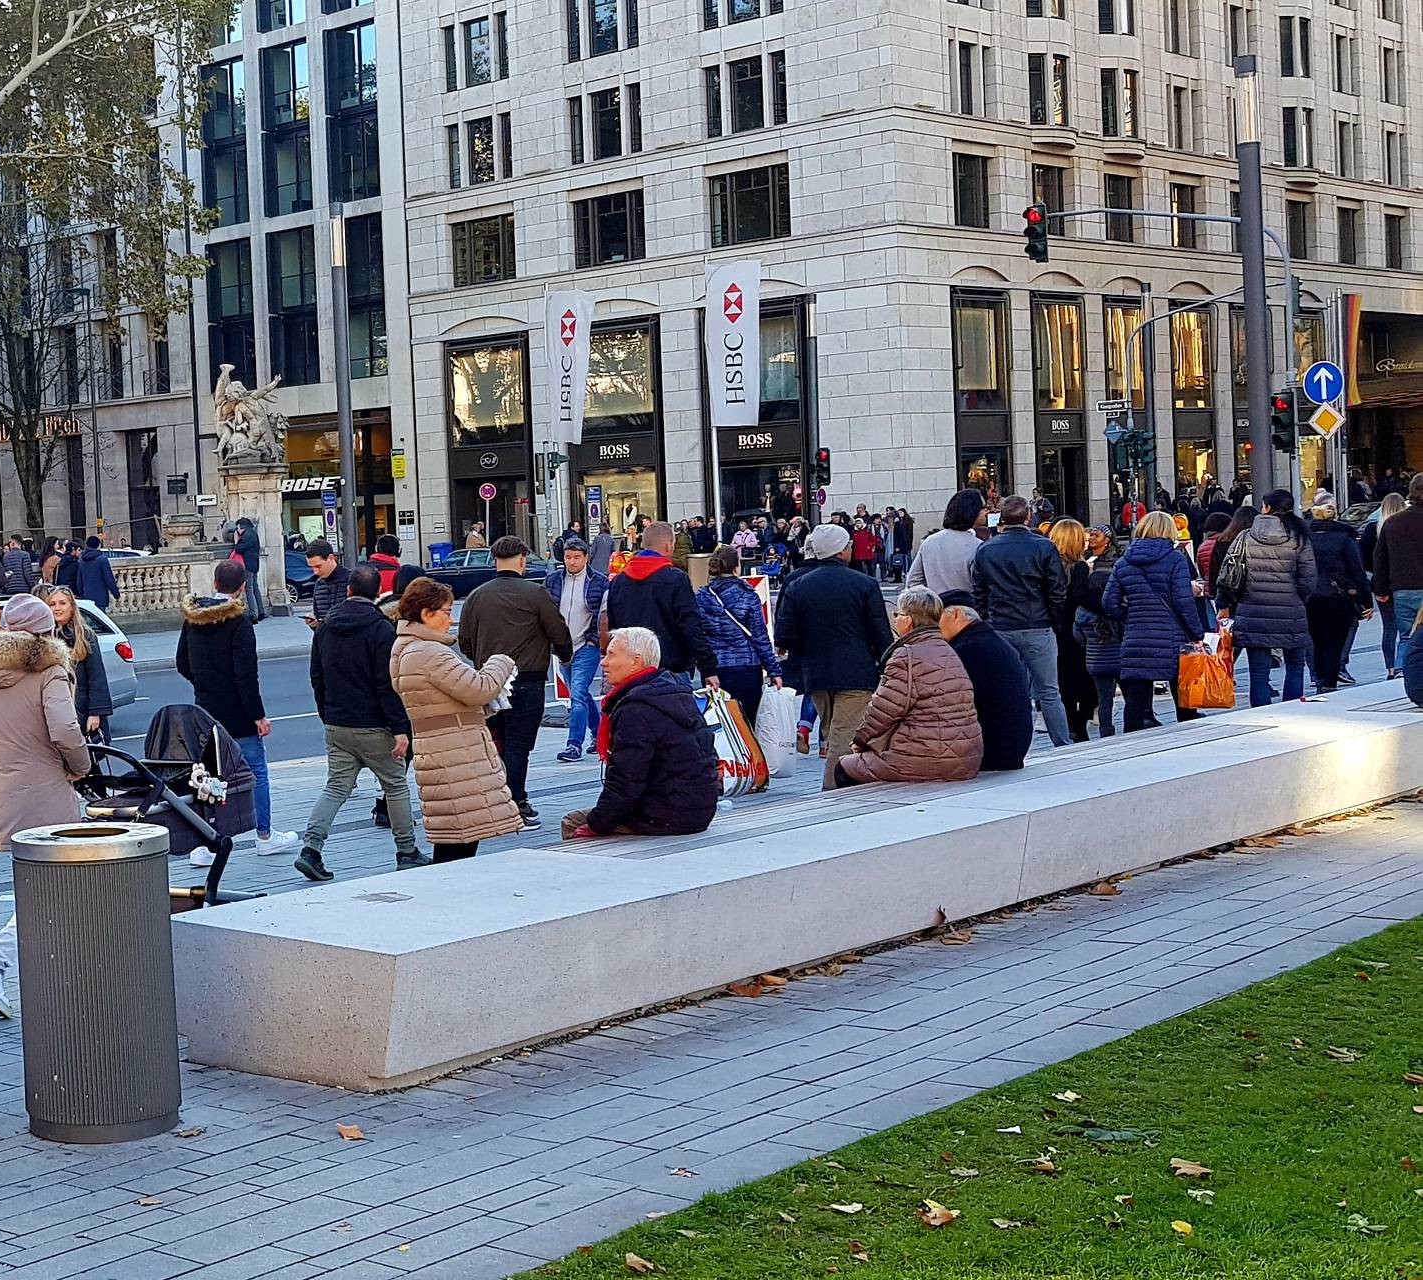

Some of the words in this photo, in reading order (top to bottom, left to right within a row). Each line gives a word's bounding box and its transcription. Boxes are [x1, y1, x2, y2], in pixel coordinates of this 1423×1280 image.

[724, 332, 746, 406] HSBC
[560, 355, 573, 422] HSBC
[1051, 420, 1070, 430] BOSS
[738, 432, 773, 446] BOSS
[599, 443, 631, 456] BOSS
[280, 476, 341, 492] BOSE
